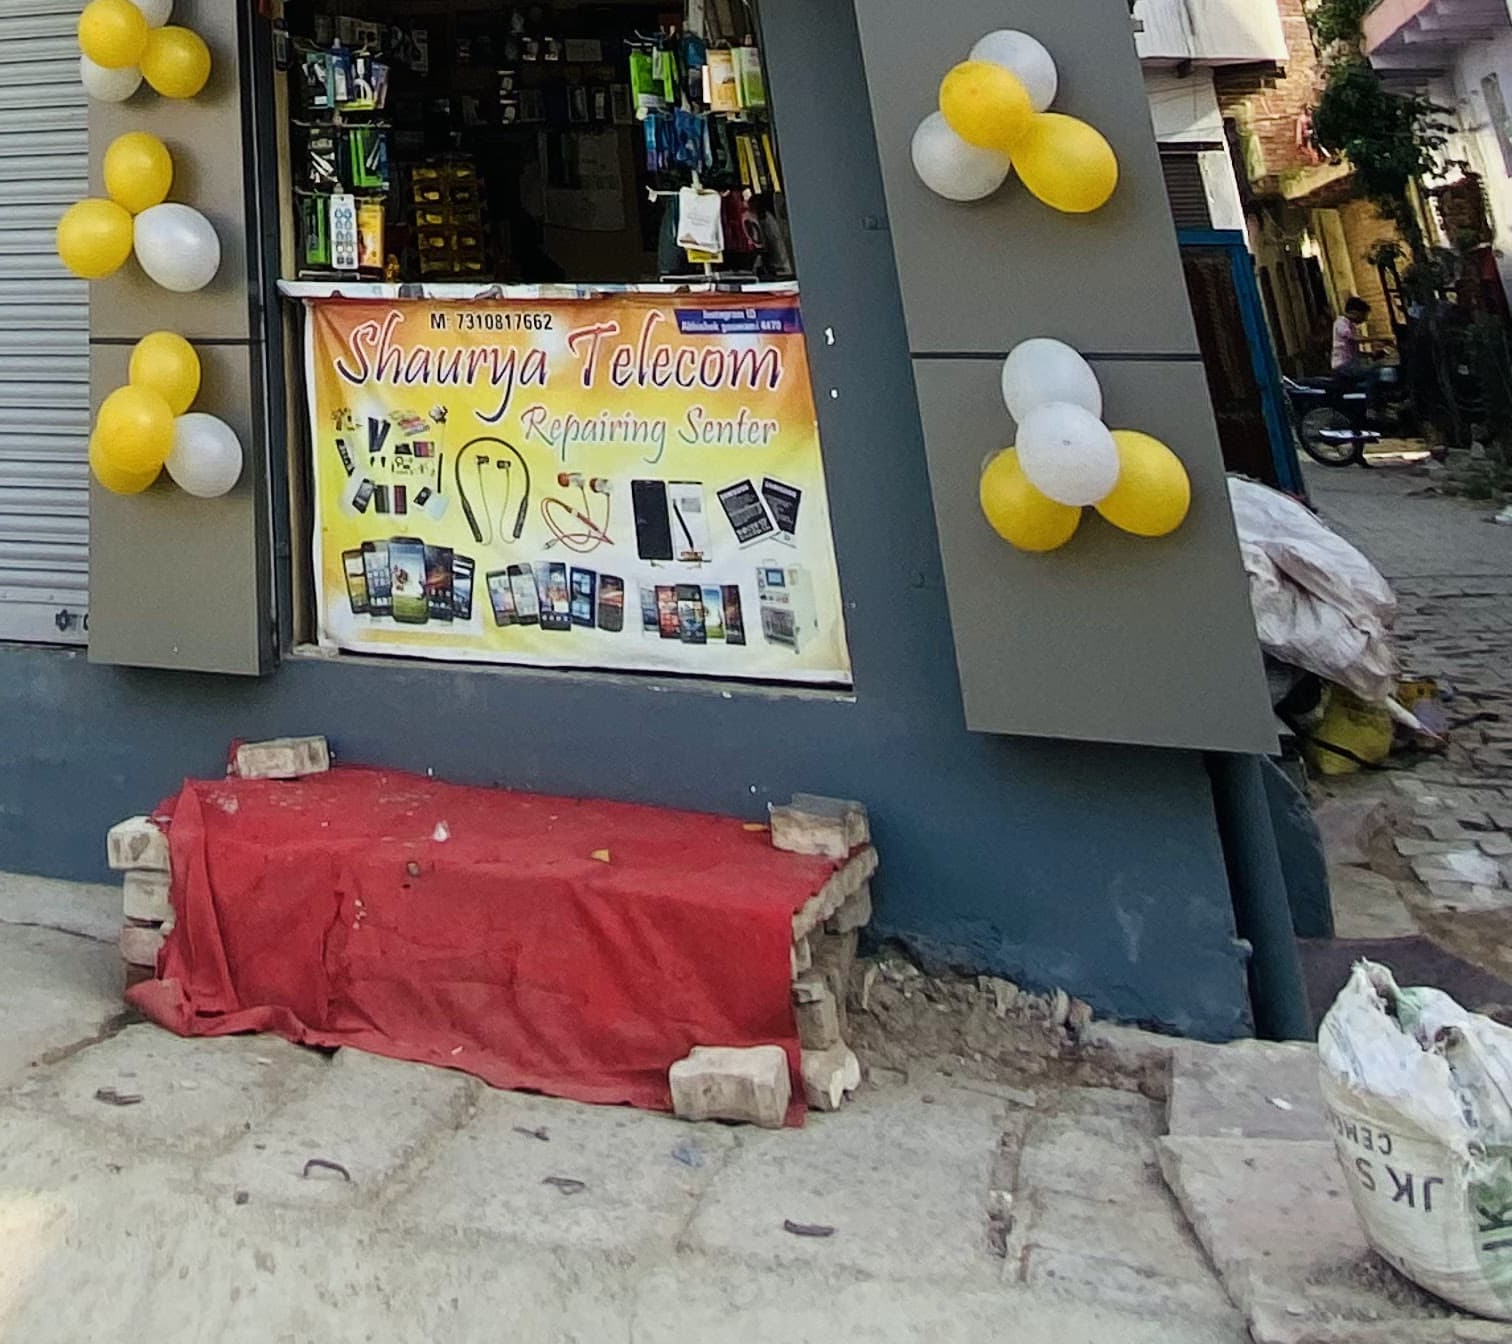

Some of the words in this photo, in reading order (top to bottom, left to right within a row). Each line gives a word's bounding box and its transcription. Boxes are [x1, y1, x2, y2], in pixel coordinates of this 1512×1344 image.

[456, 313, 552, 330] 7310817662
[337, 311, 548, 423] Shaurya
[567, 310, 781, 389] Telecom
[520, 405, 666, 465] Repairing
[678, 406, 778, 445] Senter
[1385, 1164, 1444, 1213] JK
